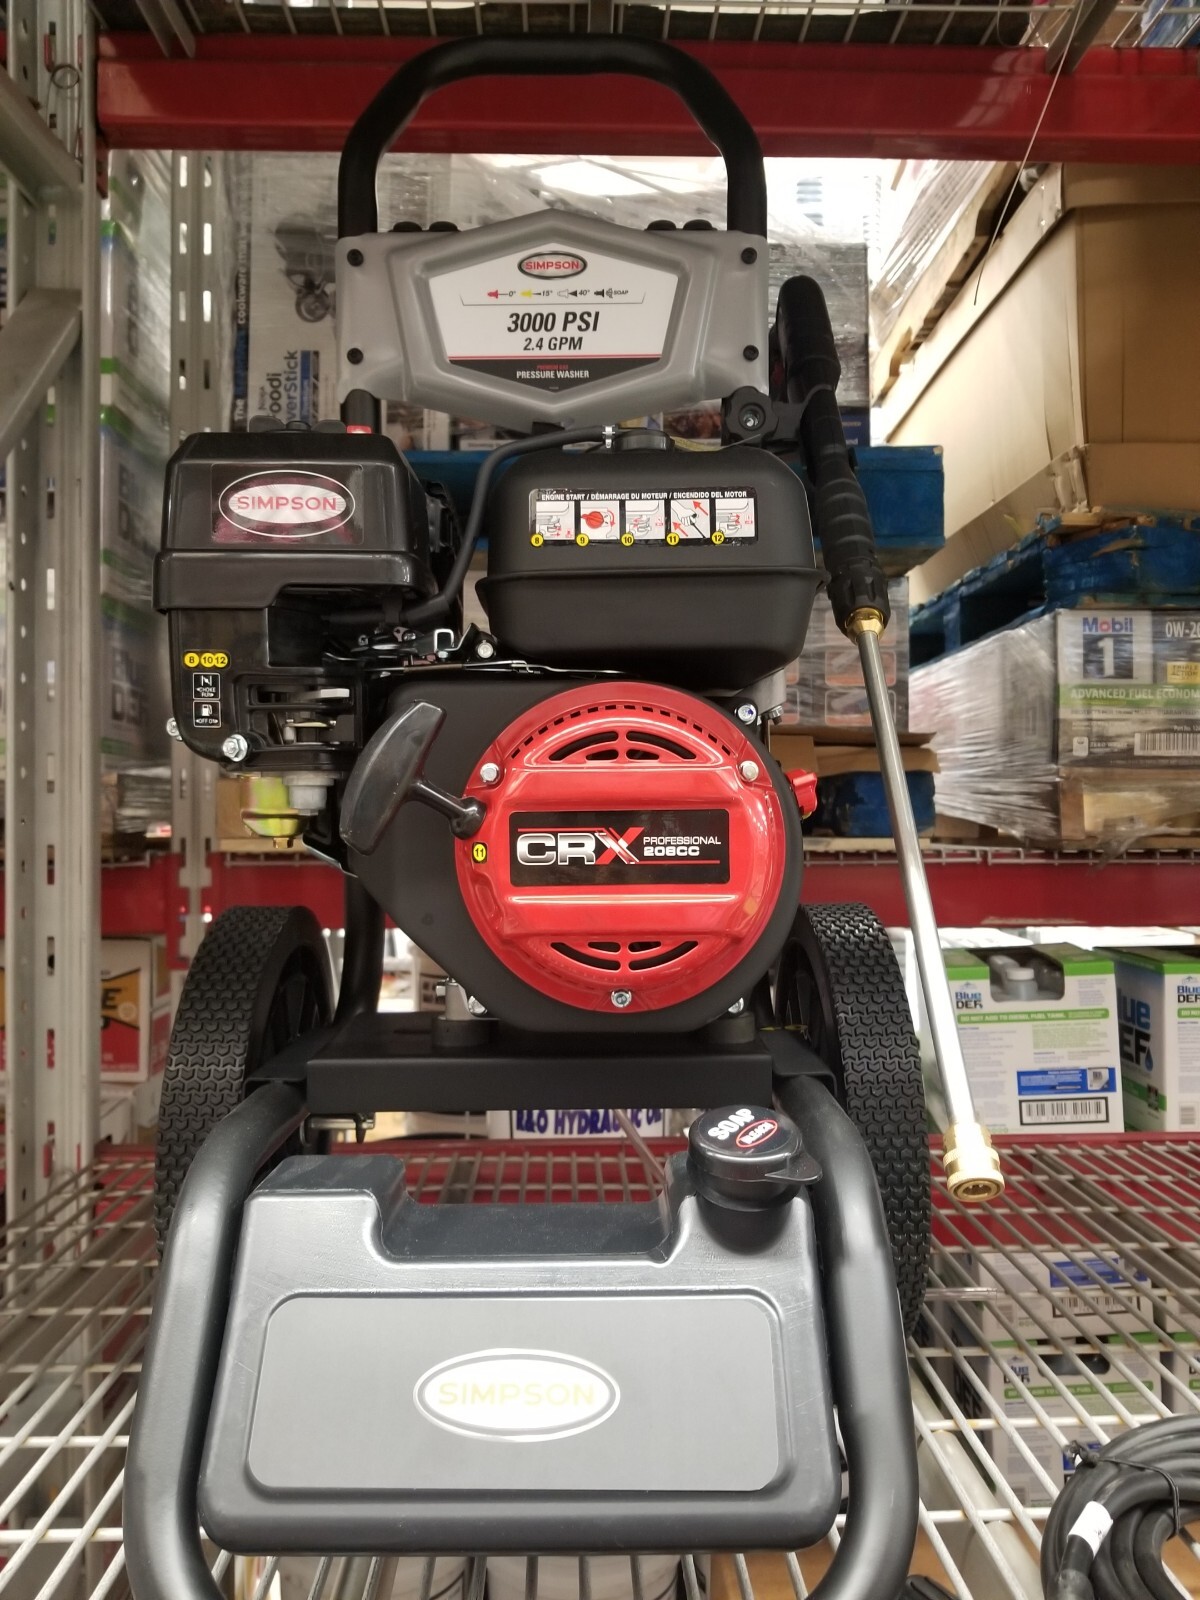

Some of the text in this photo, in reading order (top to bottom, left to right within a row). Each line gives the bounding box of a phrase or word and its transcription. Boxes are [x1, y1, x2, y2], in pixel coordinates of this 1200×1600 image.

[525, 261, 580, 270] SIMPSON
[236, 267, 248, 324] cookware
[507, 311, 600, 332] 3000 PSI
[523, 336, 583, 351] 2.4 GPM
[516, 370, 589, 379] PRESSURE WASHER
[284, 350, 298, 420] verStick
[237, 496, 337, 510] SIMPSON
[591, 492, 629, 500] DÉMARRAGE
[580, 536, 585, 544] 9
[1083, 617, 1133, 632] Mobil
[202, 656, 213, 664] 10
[215, 656, 226, 664] 12
[1097, 637, 1115, 677] 1
[1070, 688, 1126, 699] ADVANCED
[1129, 688, 1153, 698] FUEL
[516, 827, 644, 866] CRX
[643, 836, 721, 845] PROFESSIONAL
[475, 848, 485, 858] 11
[643, 846, 700, 857] 208CC
[955, 991, 982, 1000] Blue
[956, 1000, 983, 1010] DEF
[1117, 987, 1151, 1030] lue
[1119, 1023, 1151, 1066] EF
[554, 1109, 641, 1135] HYDRAUIC
[707, 1108, 755, 1140] SOAP
[439, 1382, 594, 1406] SIMPSON
